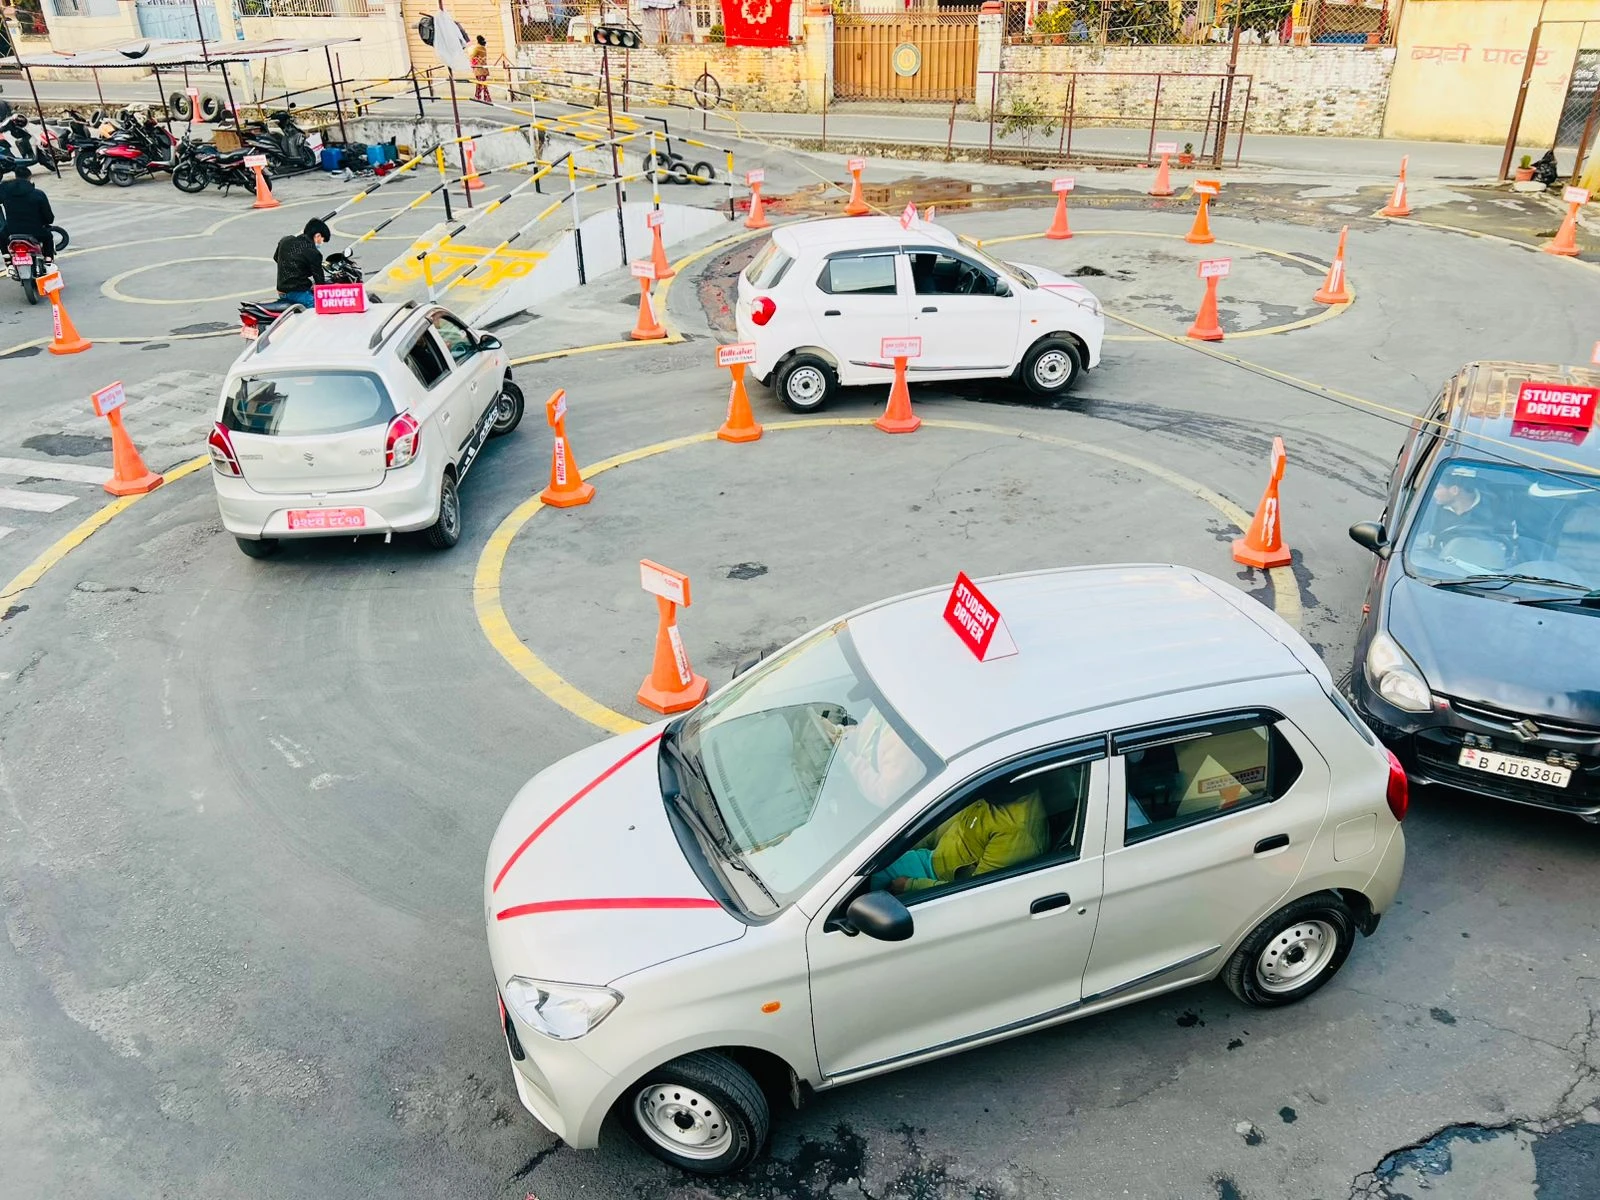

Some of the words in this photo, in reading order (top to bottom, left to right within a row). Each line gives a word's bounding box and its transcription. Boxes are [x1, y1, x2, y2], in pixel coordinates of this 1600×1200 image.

[317, 288, 359, 298] STUDENT
[322, 298, 356, 308] DRIVER
[1522, 389, 1592, 405] STUDENT
[1526, 402, 1581, 418] DRIVER
[956, 582, 995, 631] STUDENT
[953, 601, 985, 645] DRIVER
[1478, 757, 1490, 769] B
